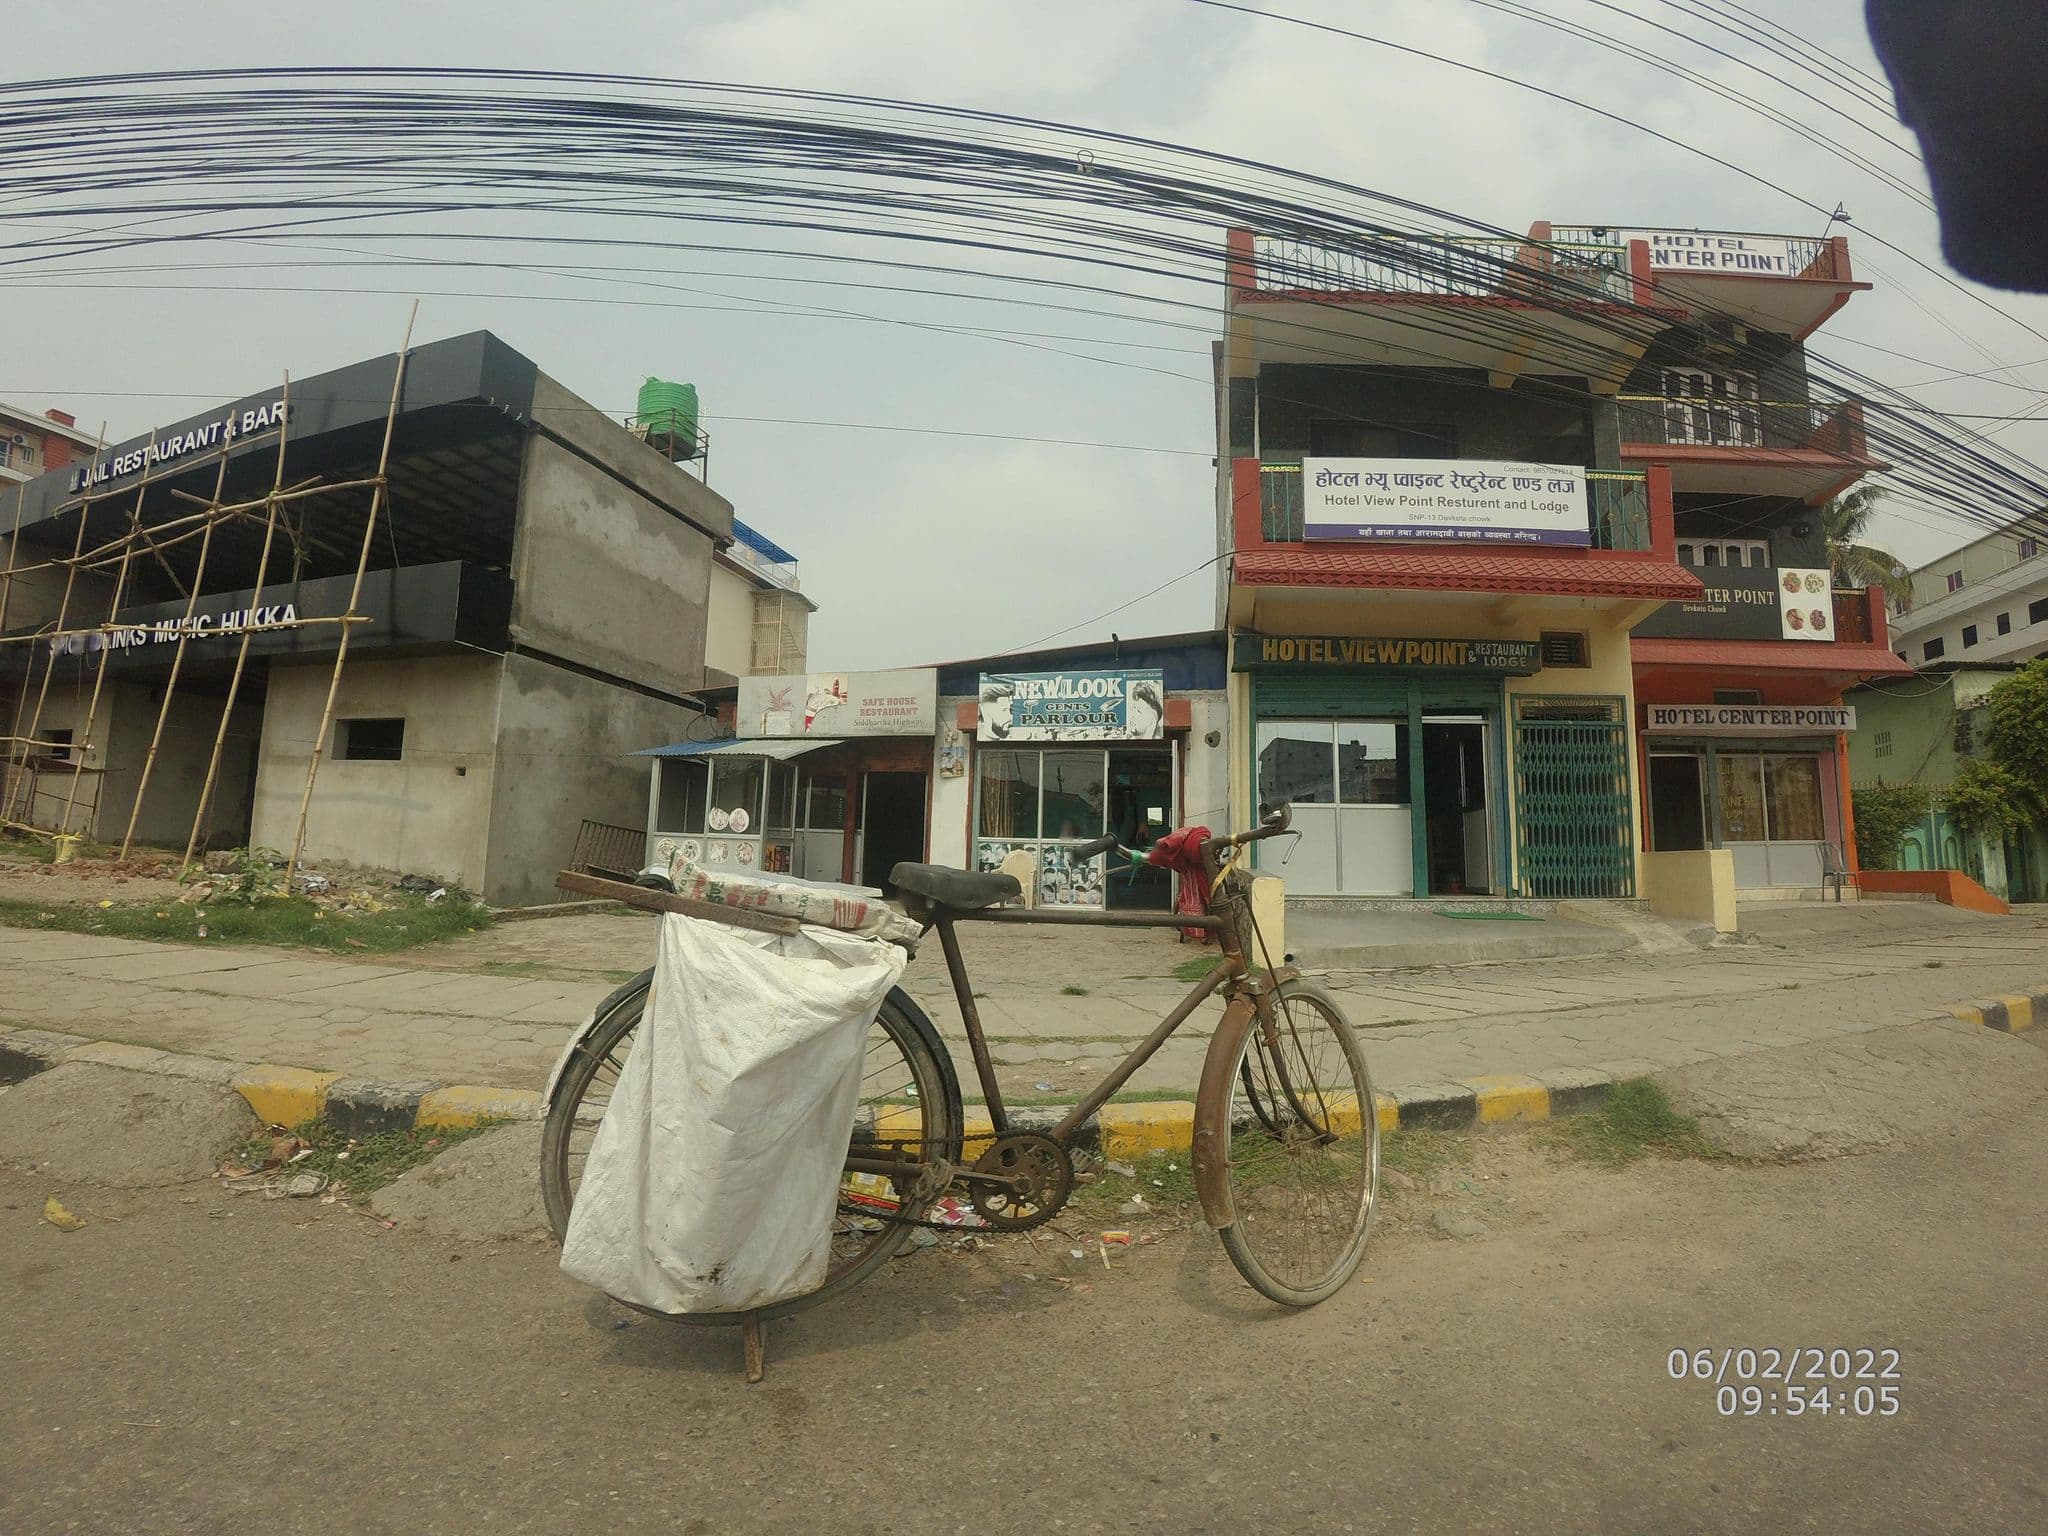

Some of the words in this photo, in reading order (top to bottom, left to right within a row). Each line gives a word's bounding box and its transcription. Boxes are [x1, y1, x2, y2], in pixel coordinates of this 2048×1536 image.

[1653, 235, 1757, 251] HOTEL
[1721, 252, 1785, 271] POINT
[113, 421, 222, 477] RESTAURANT
[242, 400, 287, 434] BAR
[1315, 467, 1361, 488] होटल
[1365, 472, 1391, 491] भ्यू
[1512, 476, 1543, 492] एण्ड
[1547, 479, 1576, 494] लज
[1325, 494, 1360, 506] Hotel
[1363, 494, 1395, 506] View
[1399, 495, 1434, 507] Point
[1437, 496, 1501, 509] Resturent
[1504, 499, 1527, 510] and
[1531, 500, 1570, 514] Lodge
[1734, 589, 1775, 605] POINT
[154, 614, 212, 643] MUSIC
[220, 603, 298, 636] HUKKA
[1262, 638, 1338, 663] HOTEL
[1475, 642, 1536, 657] RESTAURANT
[1484, 656, 1528, 668] LODGE
[1013, 679, 1060, 700] NEW
[1065, 677, 1125, 699] LOOK
[862, 698, 885, 707] SAFE
[886, 697, 916, 706] HOUSE
[1045, 702, 1090, 712] GENTS
[859, 707, 919, 717] RESTAURANT
[1020, 712, 1118, 726] PARLOUR
[1654, 709, 1715, 725] HOTEL
[1718, 709, 1793, 725] CENTER
[1795, 710, 1850, 725] POINT
